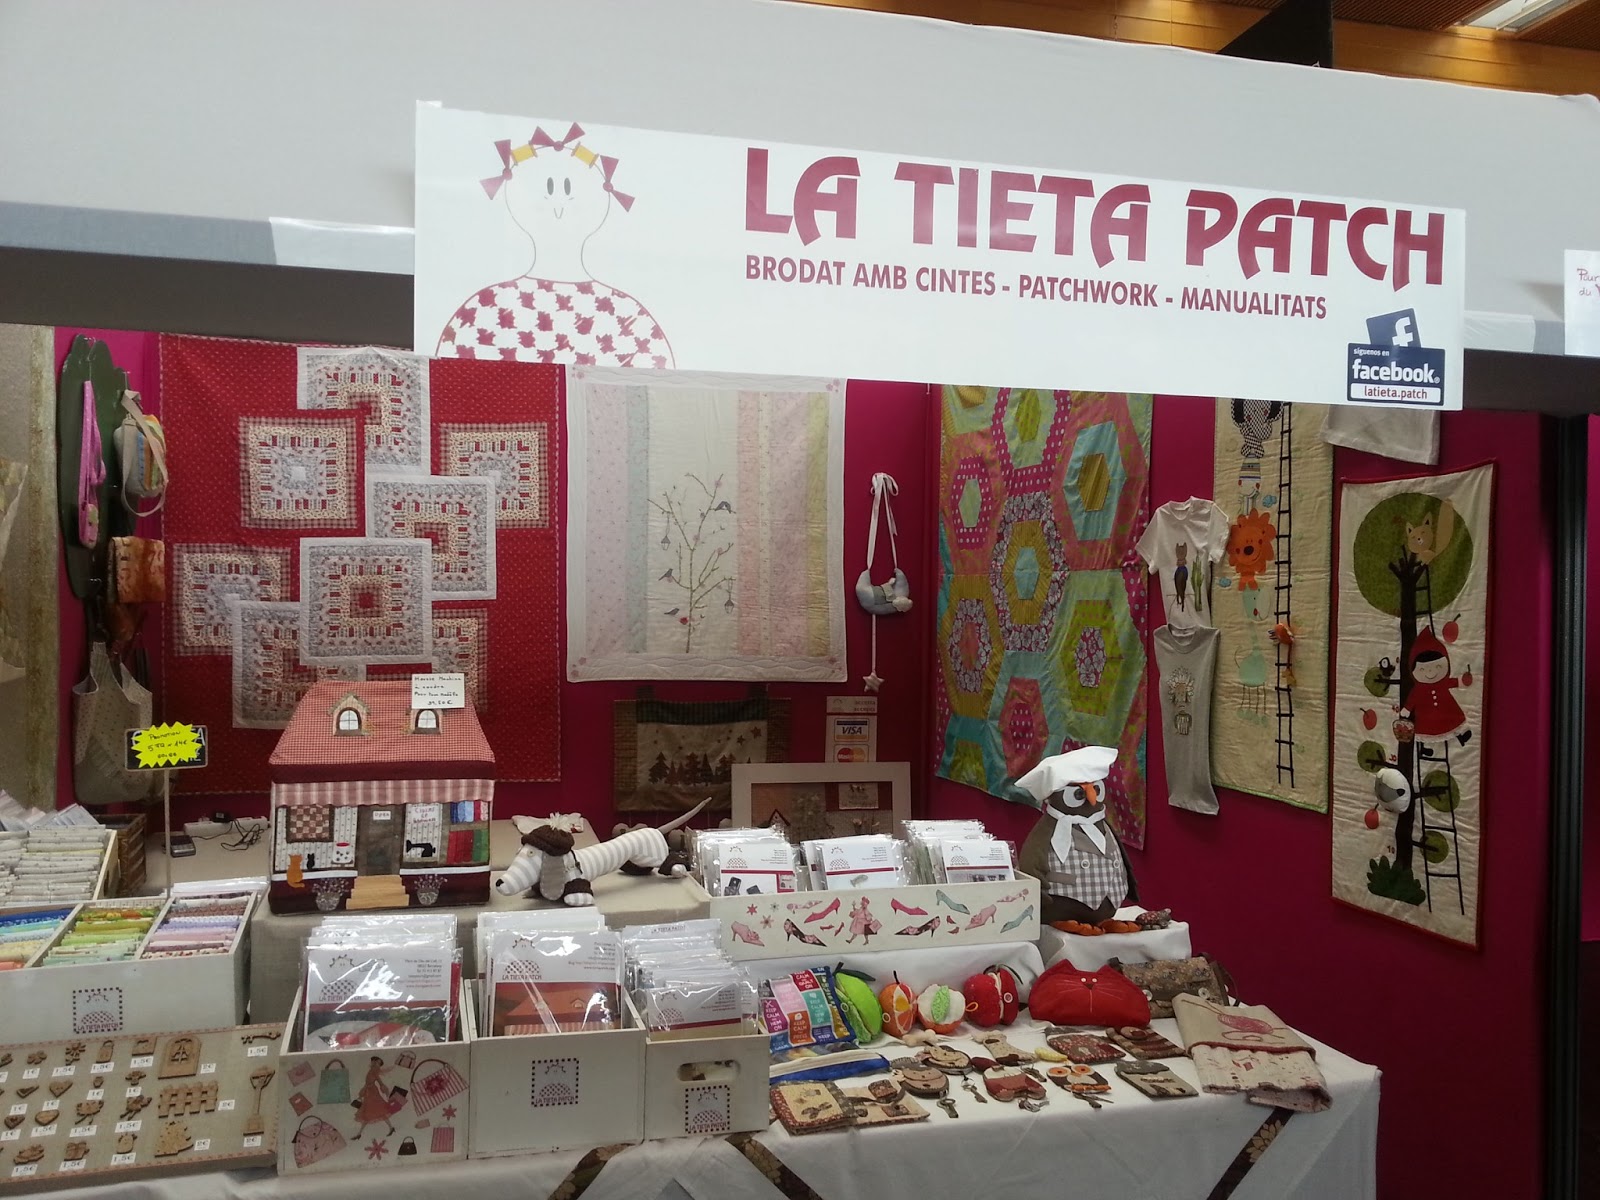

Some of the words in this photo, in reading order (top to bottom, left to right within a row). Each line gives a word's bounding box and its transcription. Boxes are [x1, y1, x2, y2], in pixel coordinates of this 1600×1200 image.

[745, 147, 861, 247] LA
[894, 161, 1151, 268] TIETA
[1186, 189, 1445, 292] PATCH
[745, 254, 846, 286] BRODAT
[853, 262, 907, 290] AMB
[915, 267, 996, 296] CINTES
[1018, 274, 1158, 308] PATCHWORK
[1180, 287, 1327, 320] MANUALITATS
[1579, 287, 1592, 296] du
[1364, 386, 1428, 400] latieta.patch
[842, 726, 862, 735] VISA
